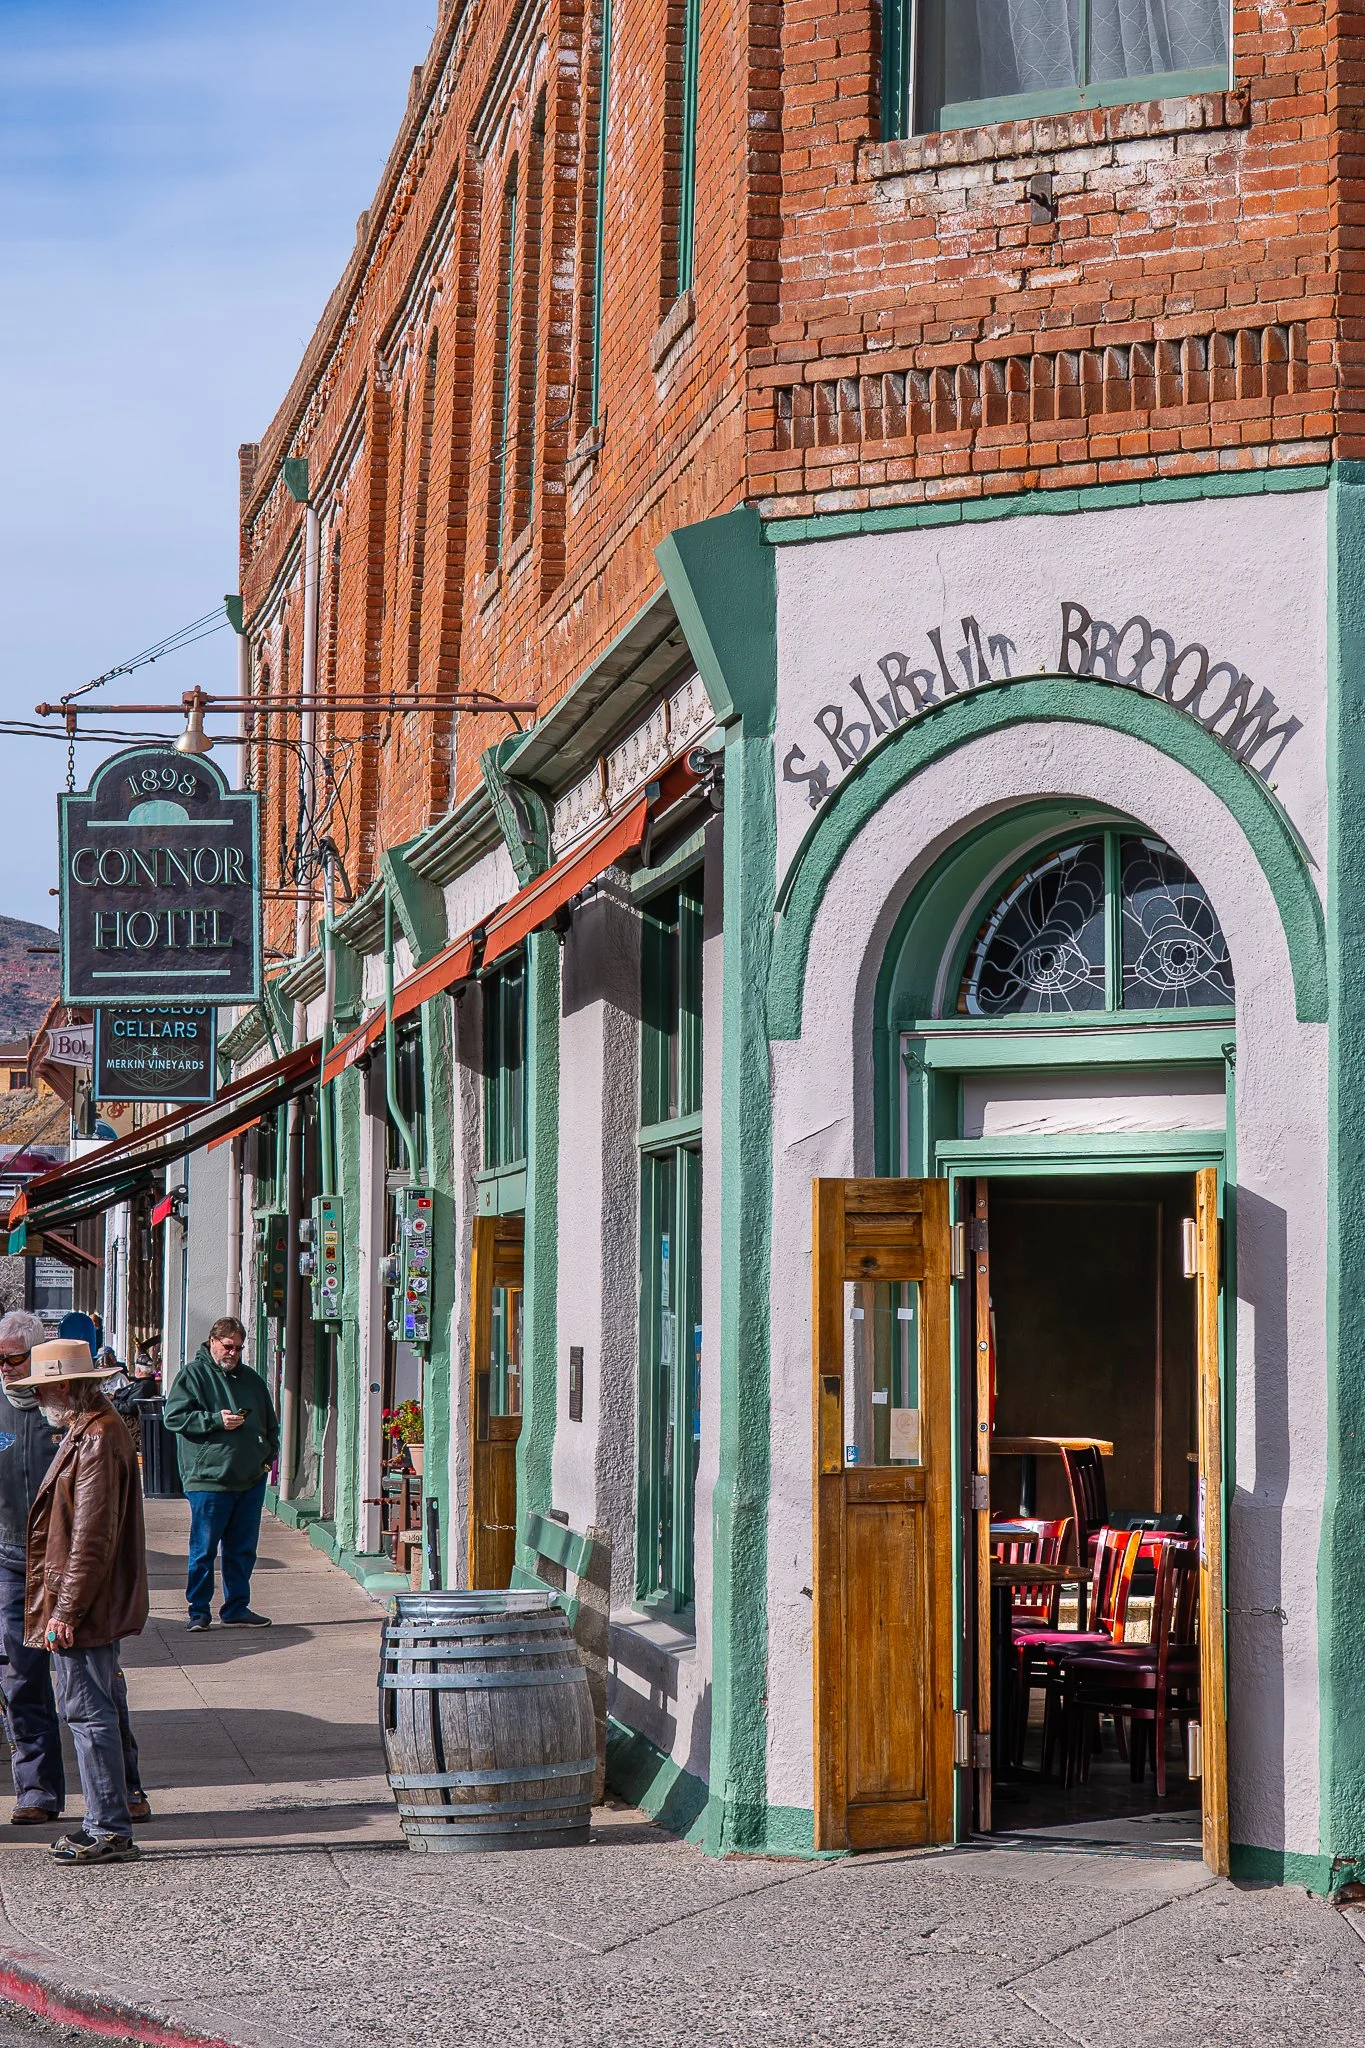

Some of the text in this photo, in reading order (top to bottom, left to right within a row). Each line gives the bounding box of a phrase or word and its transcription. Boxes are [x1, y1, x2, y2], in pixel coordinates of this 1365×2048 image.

[783, 602, 1280, 810] SPIRIT ROOM
[125, 768, 196, 798] 1898
[72, 847, 251, 887] CONNOR
[92, 907, 233, 950] HOTEL
[113, 1020, 198, 1038] CELLARS
[106, 1059, 204, 1070] MERKIN VINEYARDS
[152, 1047, 159, 1056] &
